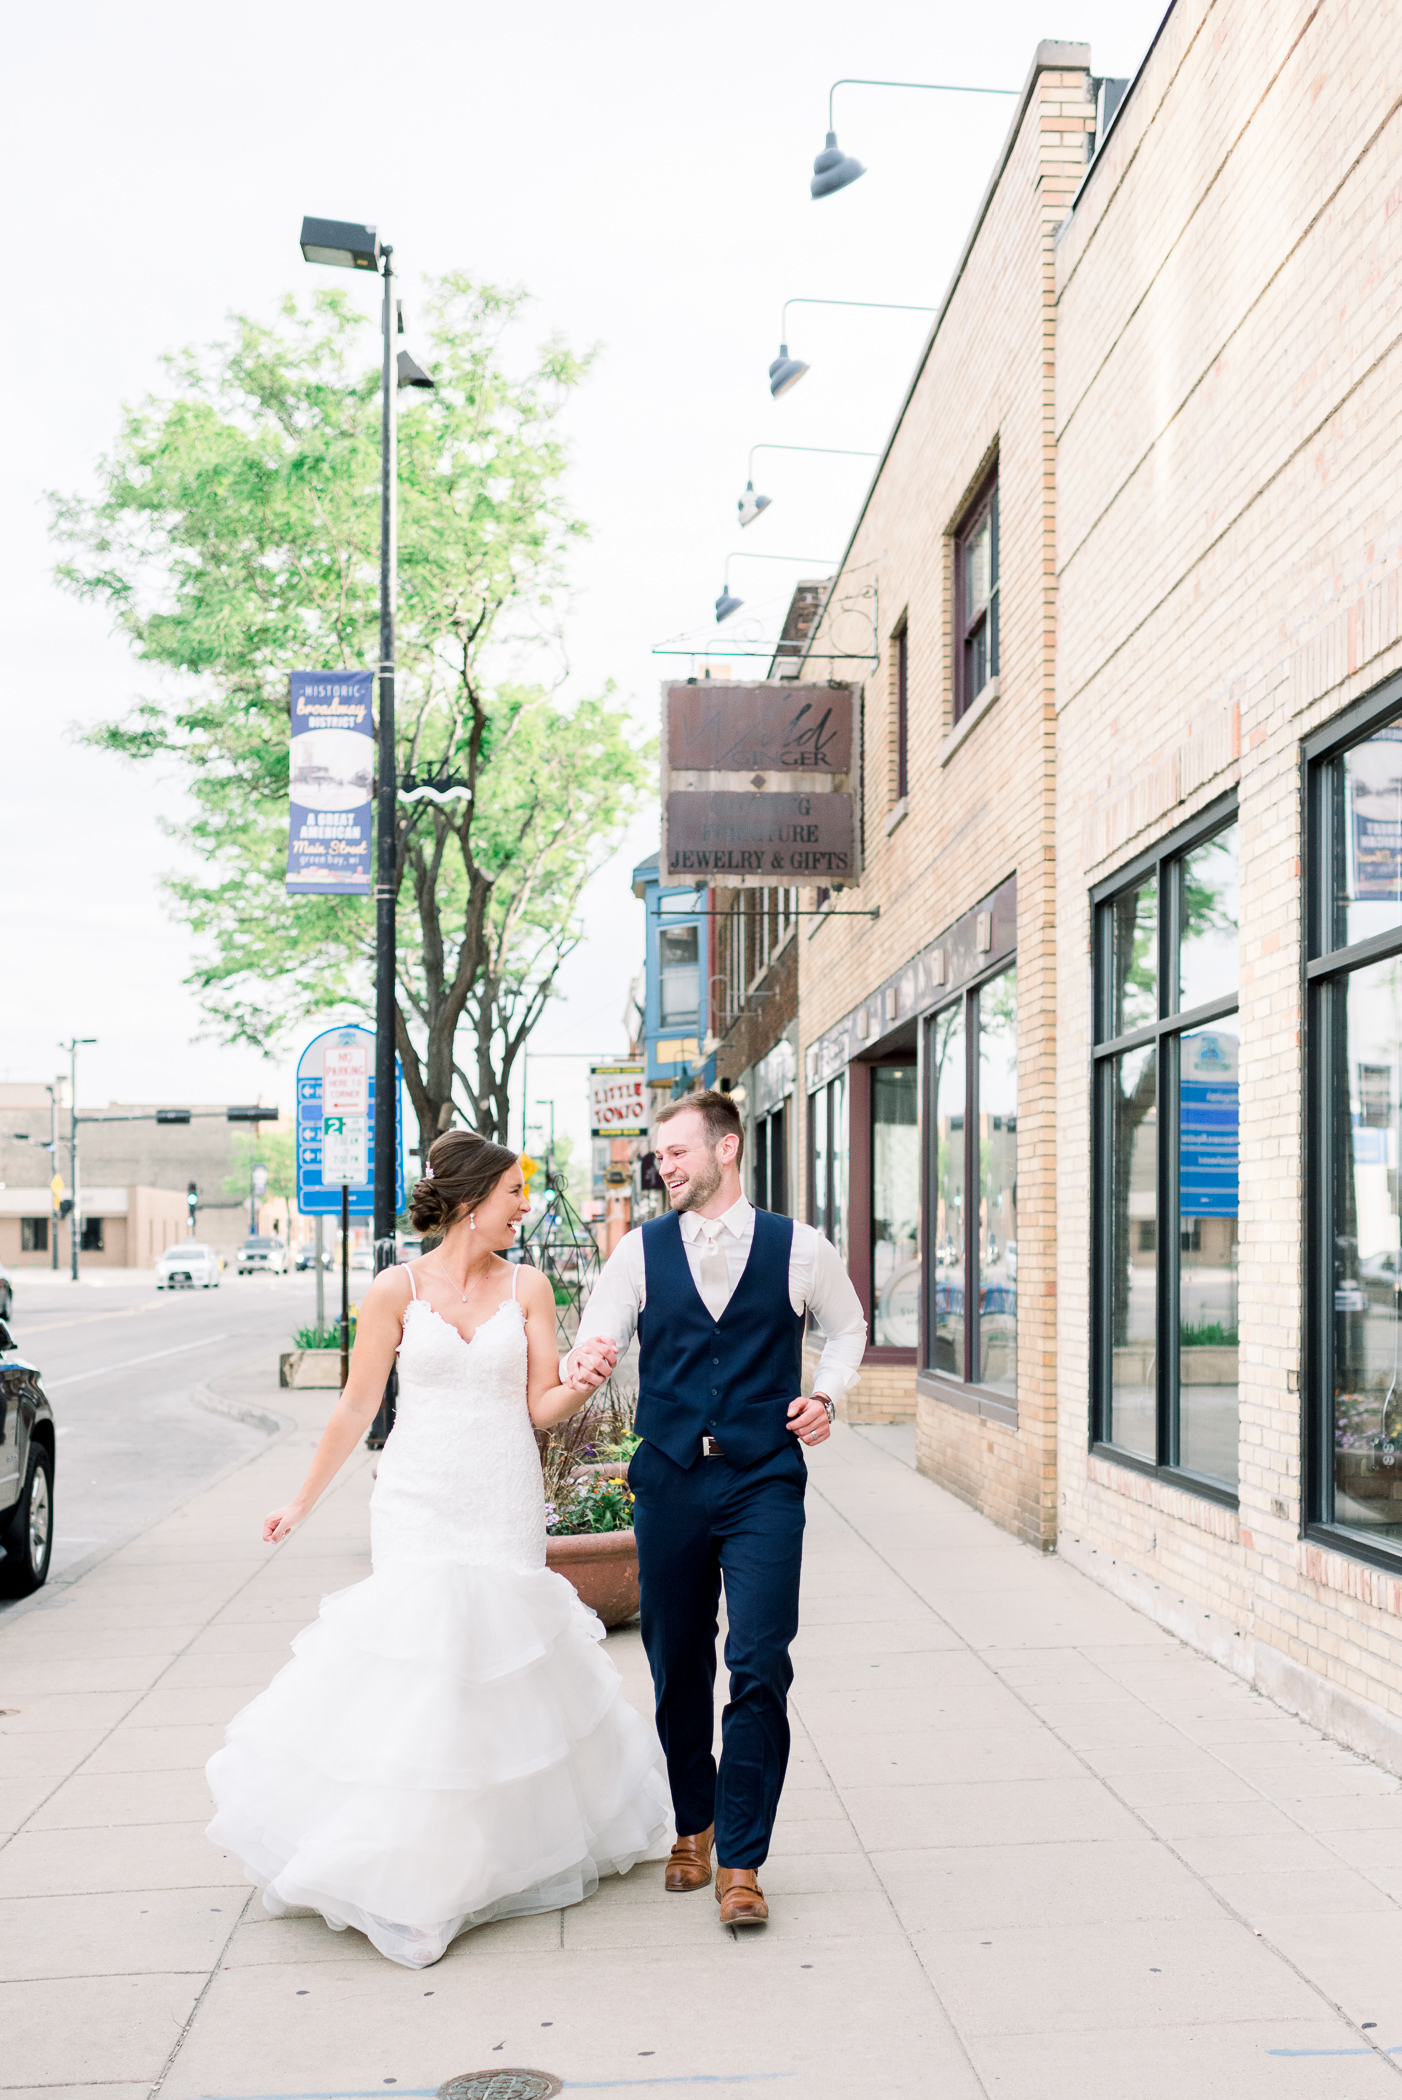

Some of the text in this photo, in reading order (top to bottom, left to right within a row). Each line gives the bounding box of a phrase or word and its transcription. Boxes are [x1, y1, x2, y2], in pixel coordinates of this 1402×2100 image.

[305, 685, 360, 697] HISTORIC
[296, 696, 367, 723] broadway
[308, 716, 355, 729] DISTRICT
[731, 750, 832, 766] GINGER
[306, 812, 355, 826] A GREAT
[299, 825, 361, 839] AMERICAN
[702, 824, 819, 843] FURTURE
[292, 840, 368, 855] Main Street
[299, 856, 326, 866] green
[671, 850, 848, 870] JEWELRY & GIFTS
[338, 1052, 353, 1063] NO
[326, 1066, 364, 1076] PARKING
[330, 1090, 360, 1099] CORNER
[595, 1082, 642, 1103] LITTLE
[327, 1119, 340, 1135] 2
